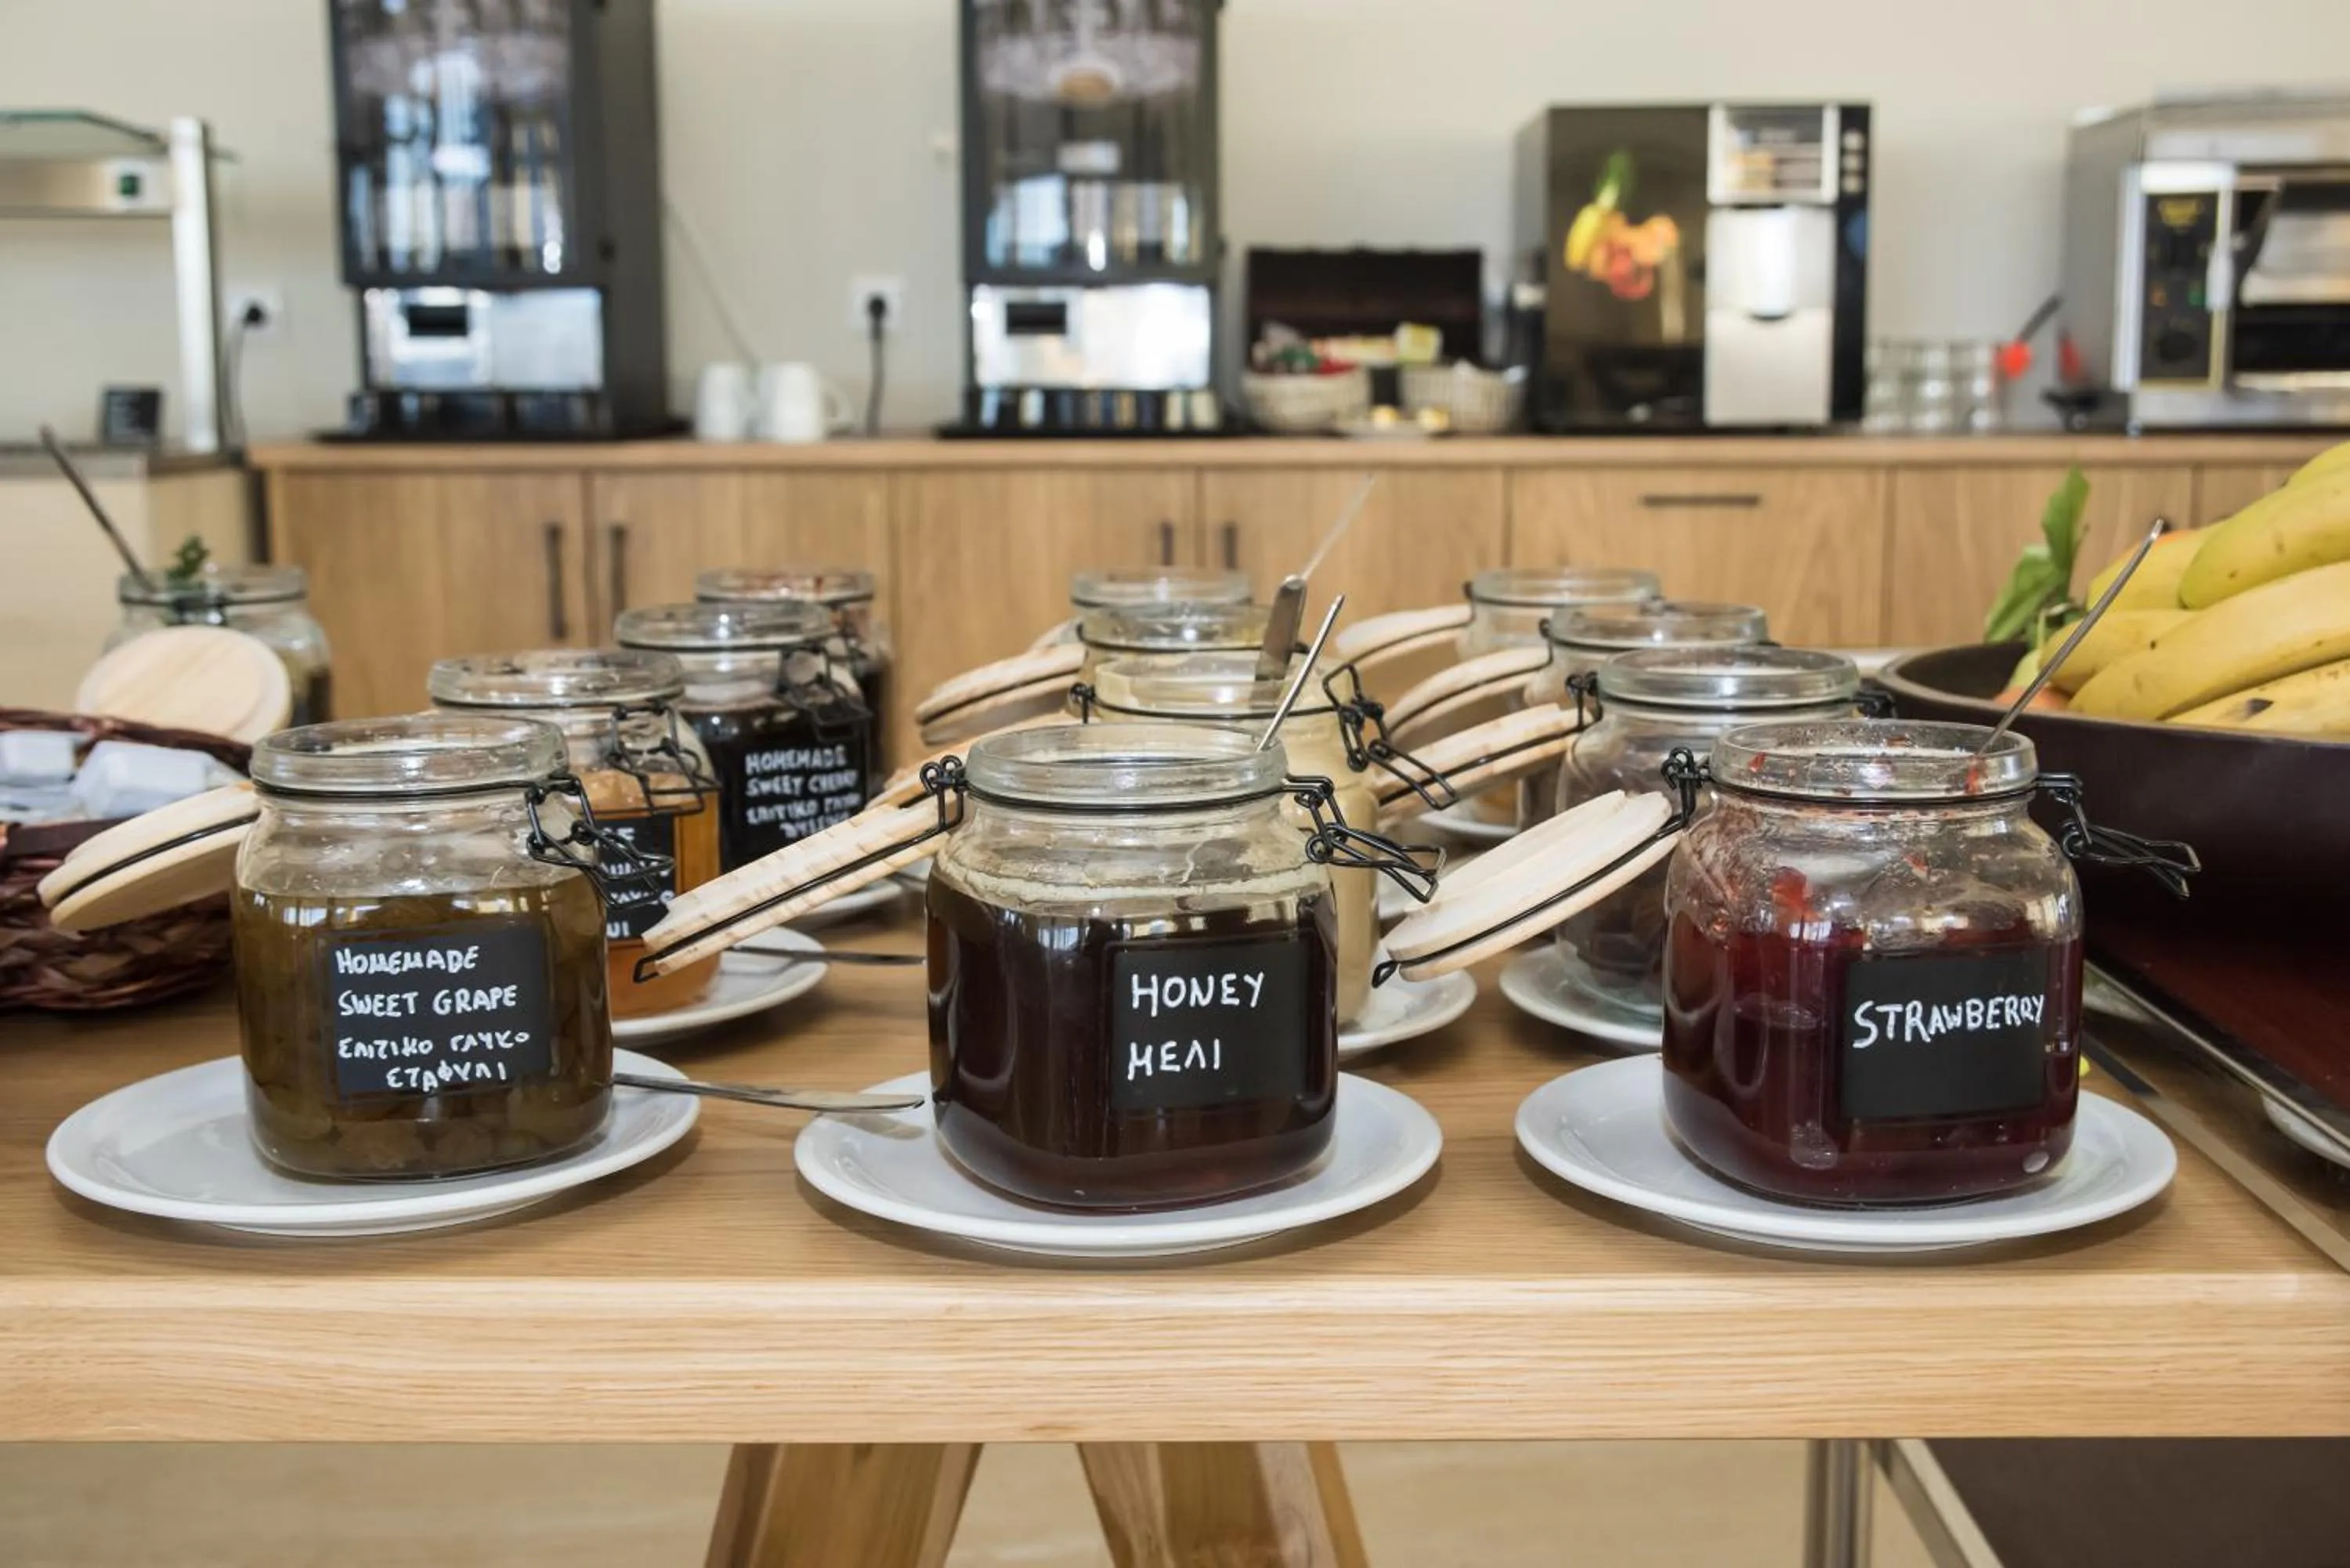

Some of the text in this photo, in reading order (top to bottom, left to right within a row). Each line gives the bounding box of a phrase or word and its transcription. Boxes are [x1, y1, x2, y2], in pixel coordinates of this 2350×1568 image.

[745, 745, 847, 775] HOMEMADE
[745, 774, 804, 797] SWEET
[334, 945, 479, 975] HOMEMADE
[338, 985, 518, 1017] SWEET GRAPE
[1131, 971, 1264, 1017] HONEY
[1853, 994, 2044, 1049] STRAWBERRY
[1127, 1038, 1220, 1081] ΜΕΛΙ
